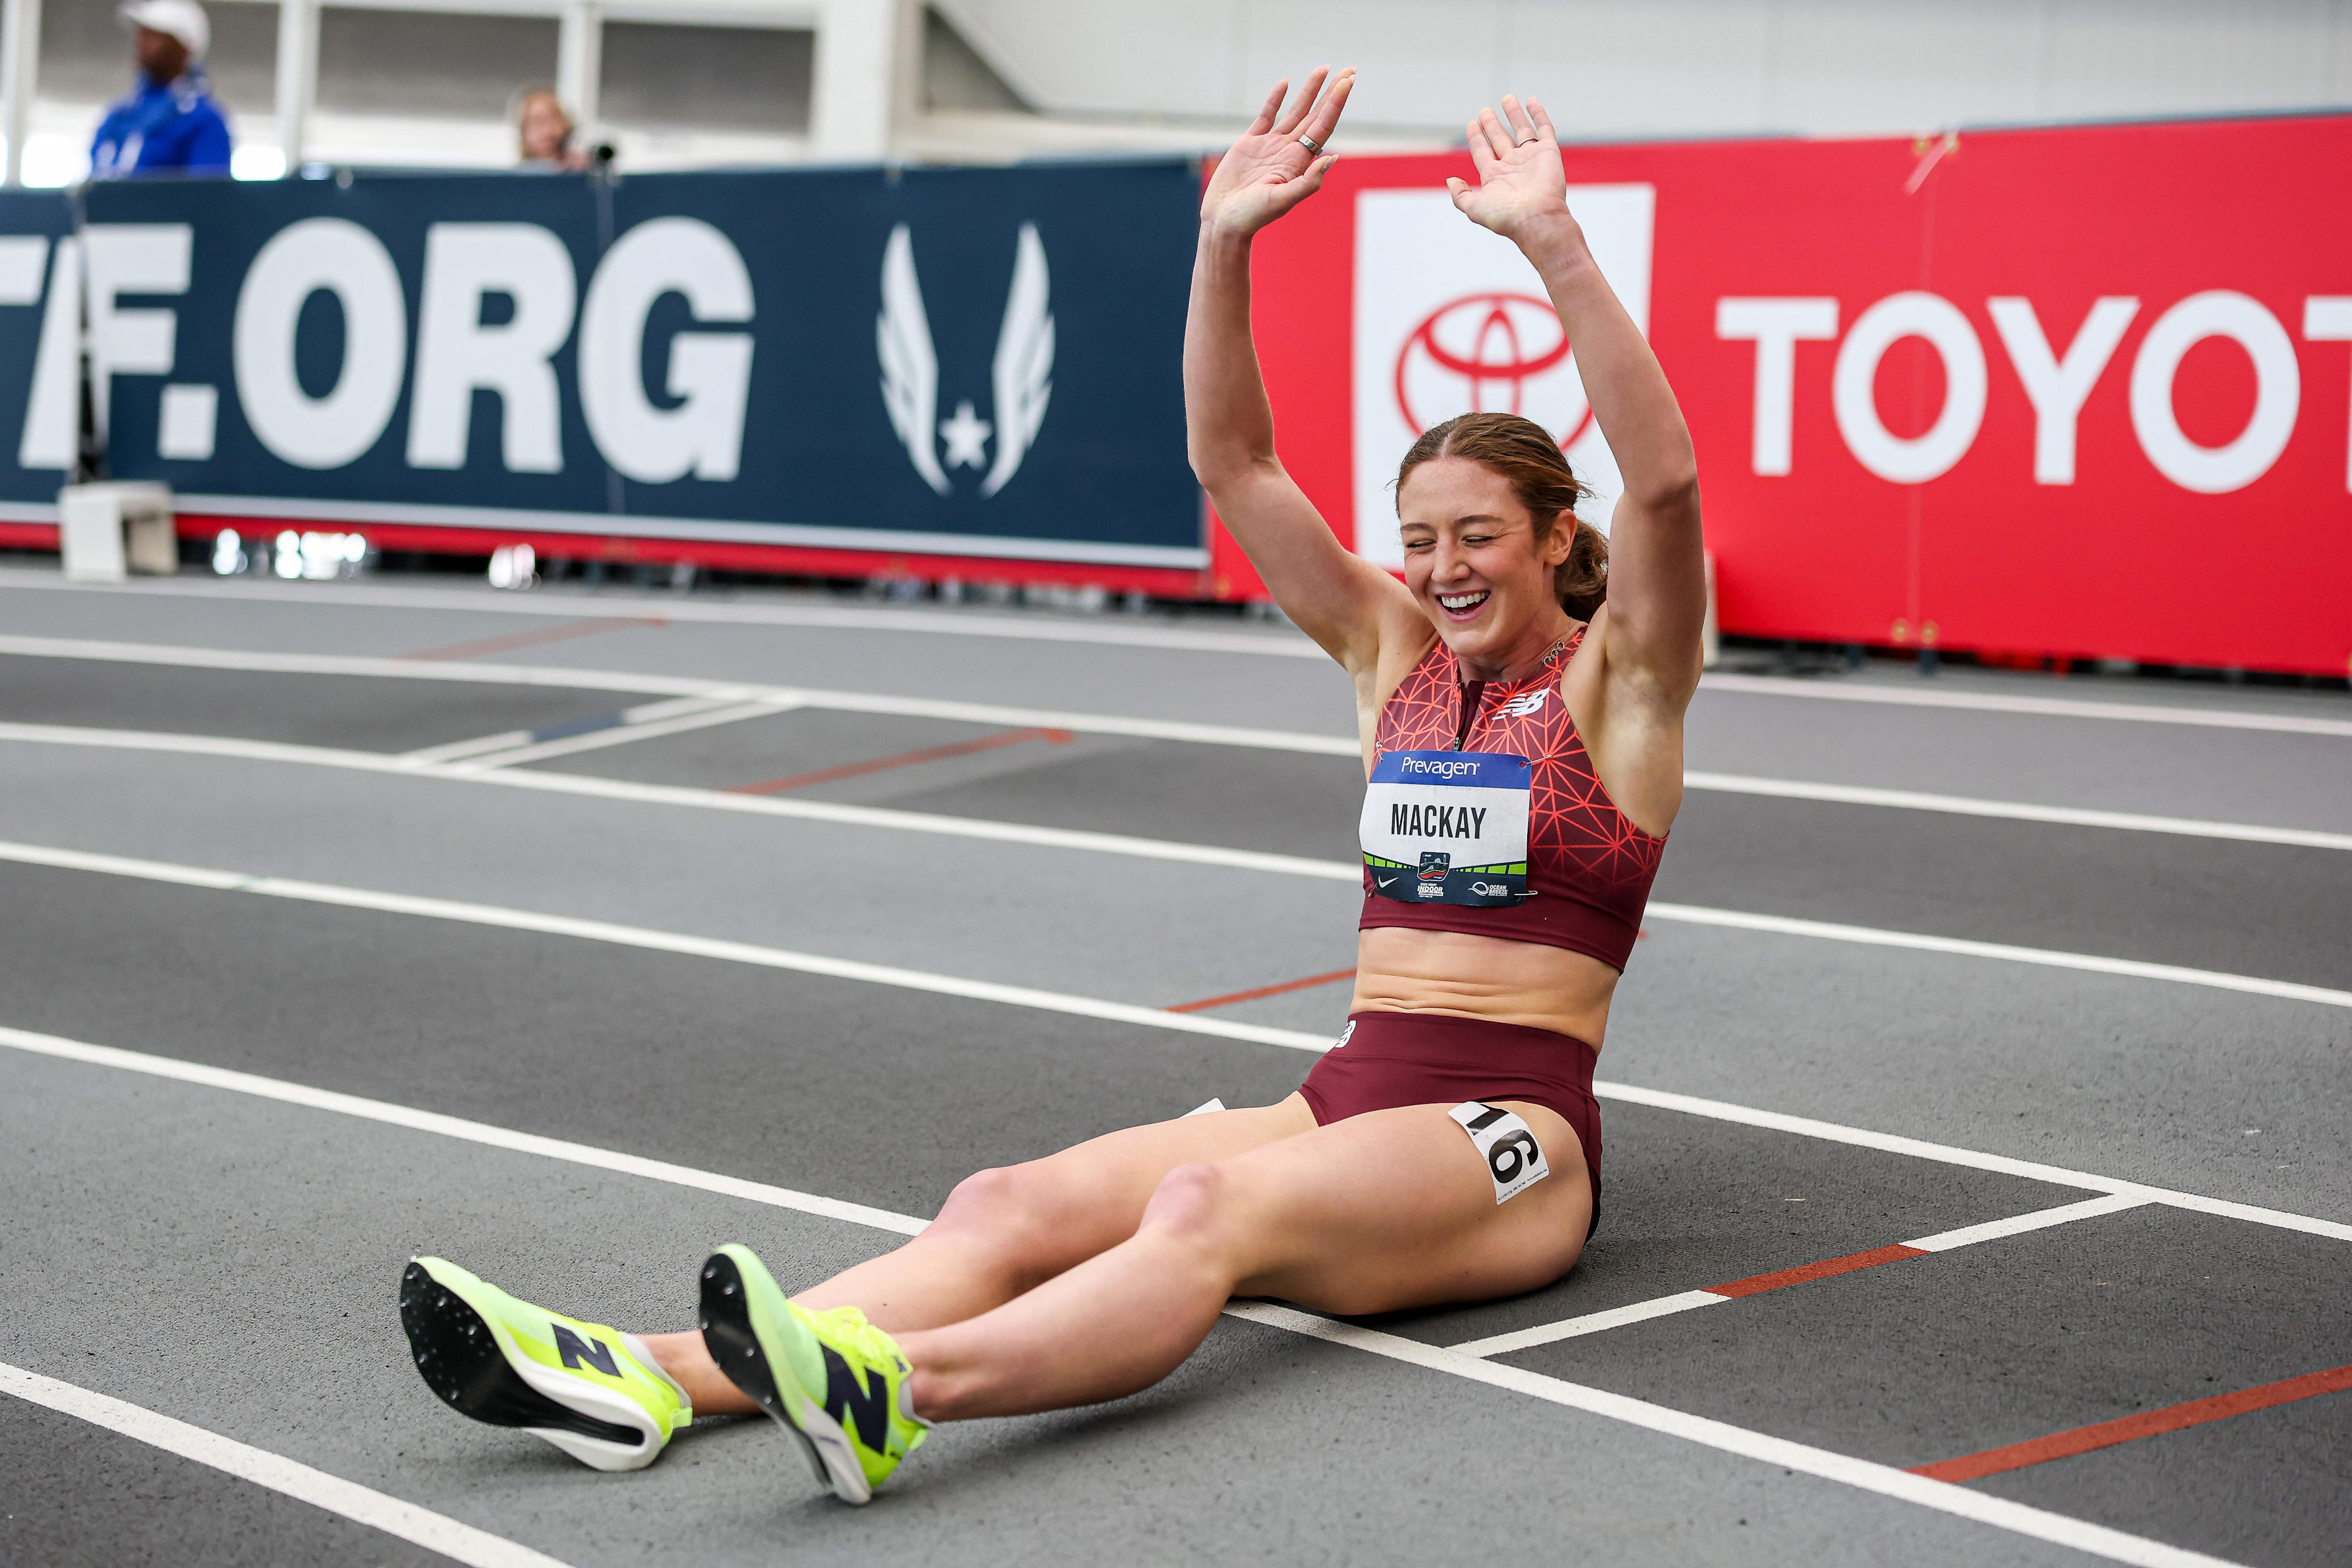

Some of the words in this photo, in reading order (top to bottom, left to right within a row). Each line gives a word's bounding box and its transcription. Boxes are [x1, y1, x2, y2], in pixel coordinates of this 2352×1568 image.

[1401, 757, 1478, 779] Prevagen
[1391, 804, 1487, 839] MACKAY
[1466, 1104, 1539, 1184] 16
[550, 1323, 624, 1379] N
[819, 1340, 888, 1457] N
